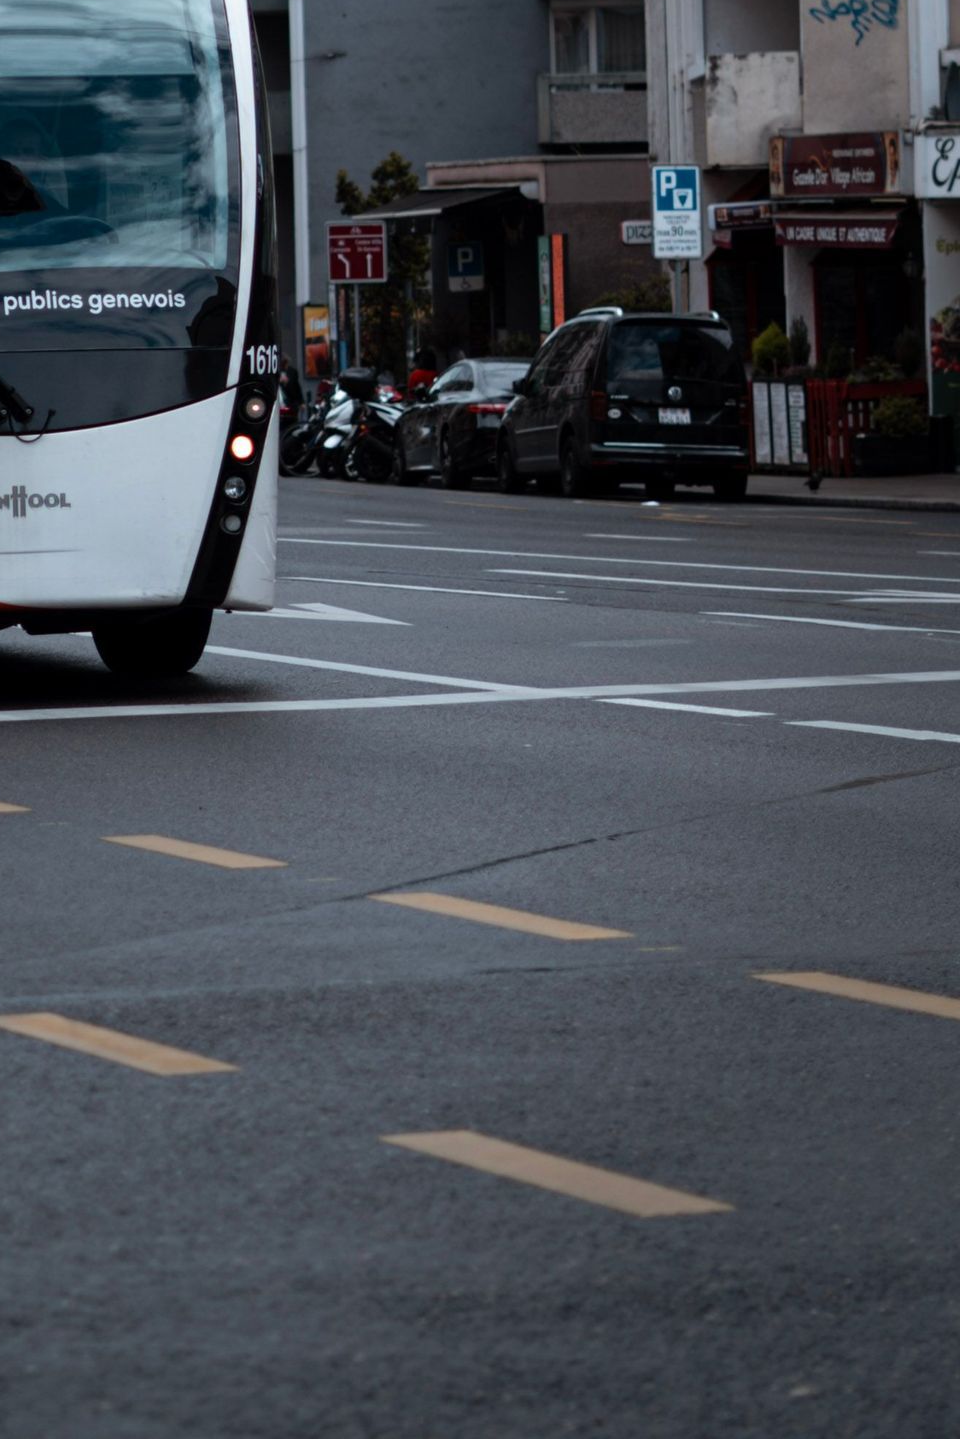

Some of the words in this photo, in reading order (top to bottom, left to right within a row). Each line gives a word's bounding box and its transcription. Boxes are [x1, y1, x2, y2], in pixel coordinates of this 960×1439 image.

[661, 171, 676, 197] P
[457, 247, 474, 272] P
[4, 289, 83, 315] publics
[89, 289, 186, 315] genevois
[246, 345, 278, 375] 1616
